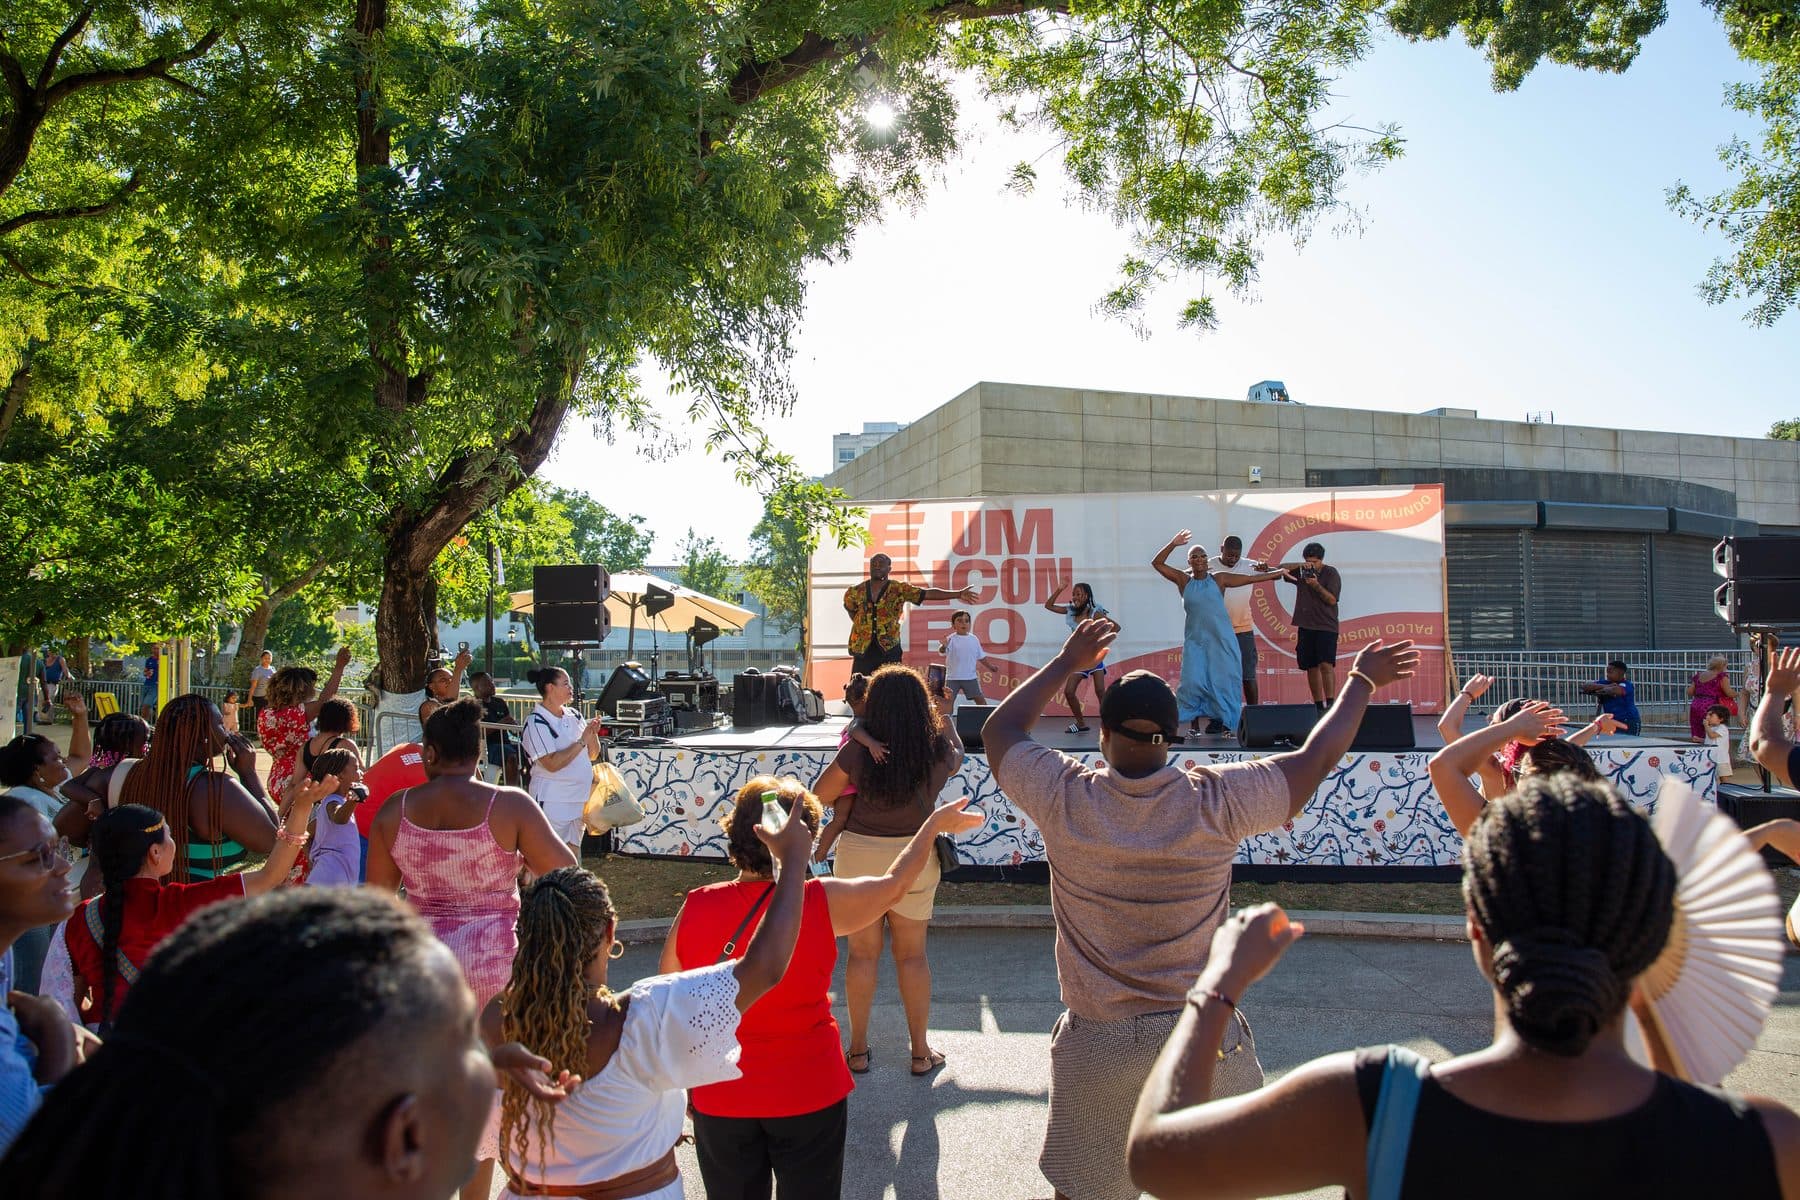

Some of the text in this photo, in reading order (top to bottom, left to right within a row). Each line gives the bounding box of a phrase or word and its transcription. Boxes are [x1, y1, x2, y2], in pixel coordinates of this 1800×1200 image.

[951, 508, 1054, 556] UM
[1258, 533, 1283, 563] ALCO
[1355, 510, 1375, 520] DO
[1380, 494, 1432, 521] MUNDO
[1254, 588, 1288, 634] MUNDO
[1385, 623, 1434, 635] PALCO
